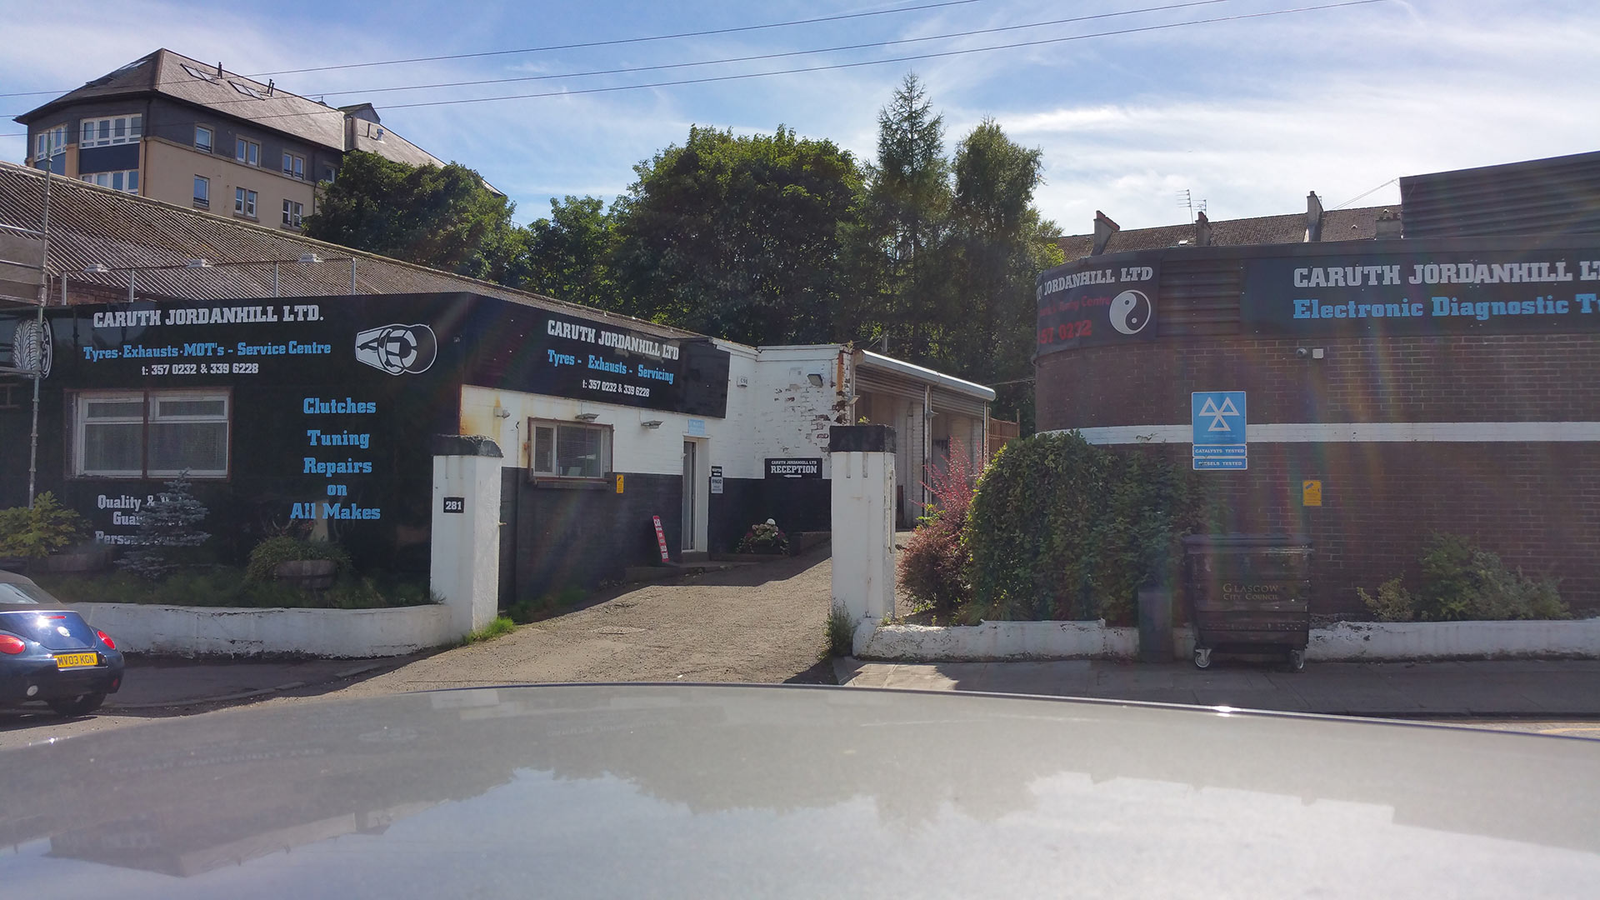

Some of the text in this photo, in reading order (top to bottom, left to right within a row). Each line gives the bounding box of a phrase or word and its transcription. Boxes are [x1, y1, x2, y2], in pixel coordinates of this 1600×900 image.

[1044, 269, 1115, 296] JORDANHILL
[1120, 266, 1154, 282] LTD
[1294, 265, 1400, 288] CARUTH
[1408, 261, 1573, 285] JORDANHILL
[93, 304, 324, 328] CARUTH JORDANHILL LTD.
[1293, 298, 1424, 319] Electronic
[1432, 295, 1569, 320] Diagnostic
[237, 342, 286, 356] Service
[288, 340, 332, 355] Centre
[547, 319, 680, 361] CARUTH JORDANHILL LTD
[151, 364, 170, 375] 357
[172, 364, 197, 375] 0232
[200, 364, 208, 374] &
[210, 363, 230, 374] 339
[232, 363, 258, 374] 6228
[548, 349, 575, 367] Tyres
[588, 354, 626, 375] Exhausts
[638, 364, 674, 385] Servicing
[588, 379, 601, 390] 357
[601, 381, 617, 393] 0232
[624, 384, 635, 395] 339
[635, 386, 650, 397] 6228
[303, 397, 377, 414] Clutches
[307, 430, 370, 449] Tuning
[303, 457, 373, 477] Repairs
[771, 465, 817, 474] RECEPTION
[327, 484, 347, 496] on
[97, 494, 141, 512] Quality
[290, 502, 381, 520] All Makes
[445, 501, 462, 510] 281
[57, 656, 79, 666] MV03
